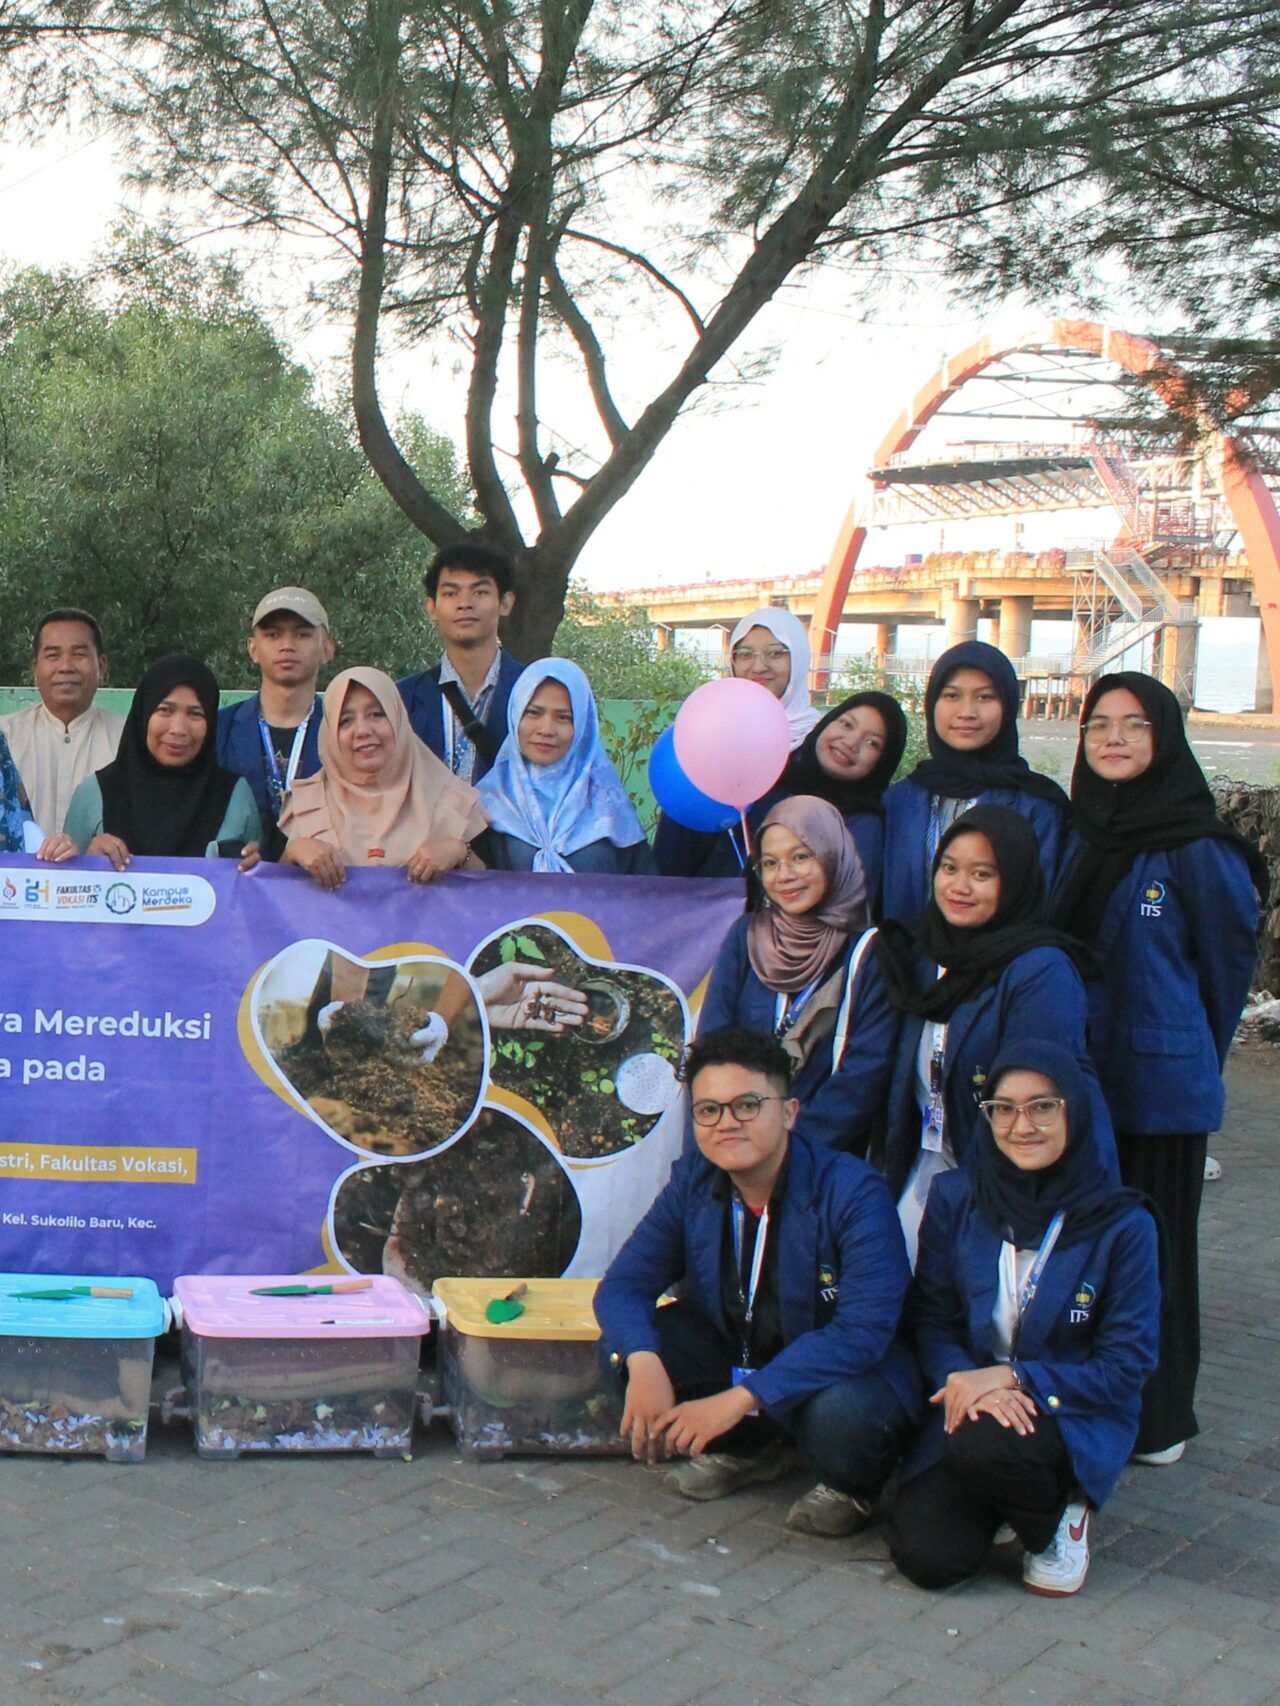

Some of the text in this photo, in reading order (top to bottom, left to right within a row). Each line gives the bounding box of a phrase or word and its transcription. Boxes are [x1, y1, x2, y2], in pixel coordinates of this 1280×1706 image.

[56, 885, 91, 894] FAKULTAS
[143, 887, 188, 898] Kampus
[57, 894, 98, 904] VOKASI ITS
[143, 896, 192, 906] Merdeka
[1141, 903, 1162, 917] ITS
[34, 1008, 211, 1039] Mereduksi
[22, 1054, 104, 1084] pada
[39, 1153, 116, 1171] Fakultas
[121, 1156, 187, 1176] Vokasi,
[2, 1213, 27, 1225] Kel.
[30, 1215, 85, 1228] Sukolilo
[89, 1217, 124, 1230] Baru,
[127, 1217, 156, 1229] Kec.
